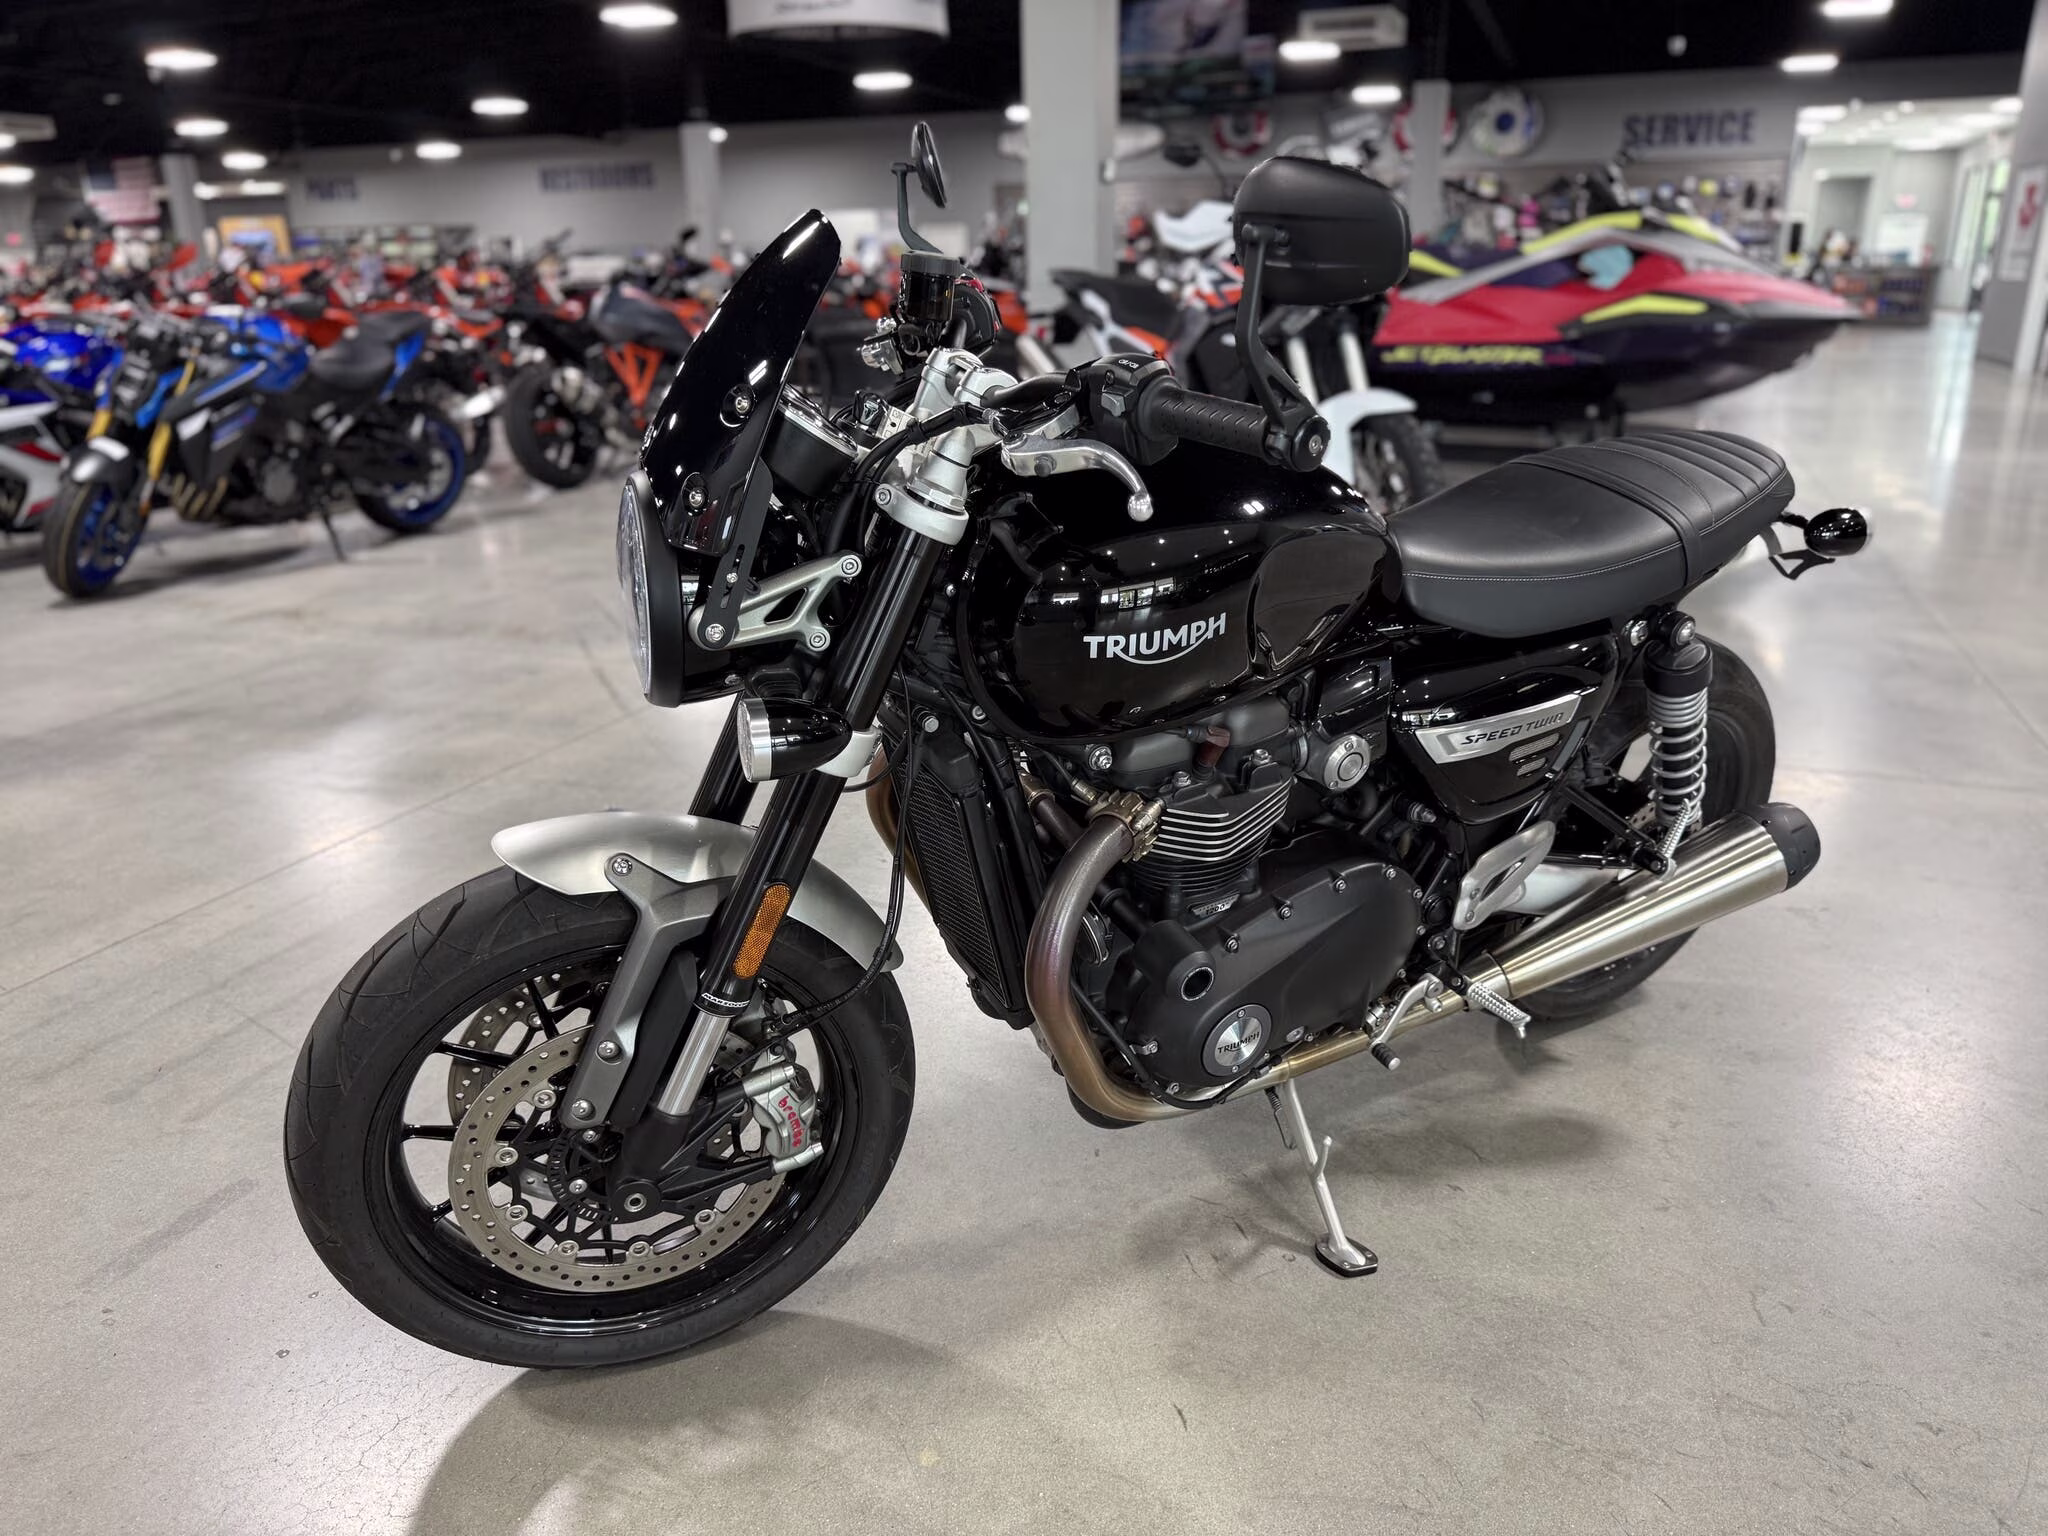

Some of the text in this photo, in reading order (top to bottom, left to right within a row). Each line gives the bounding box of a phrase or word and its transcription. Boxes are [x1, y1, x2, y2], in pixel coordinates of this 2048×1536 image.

[1623, 108, 1758, 148] SERVICE
[1083, 612, 1227, 665] TRIUMPH
[1460, 725, 1523, 746] SPEED
[701, 992, 751, 1008] MARZOCC
[1217, 1031, 1260, 1054] TRIUMPH
[778, 1095, 804, 1147] brembo
